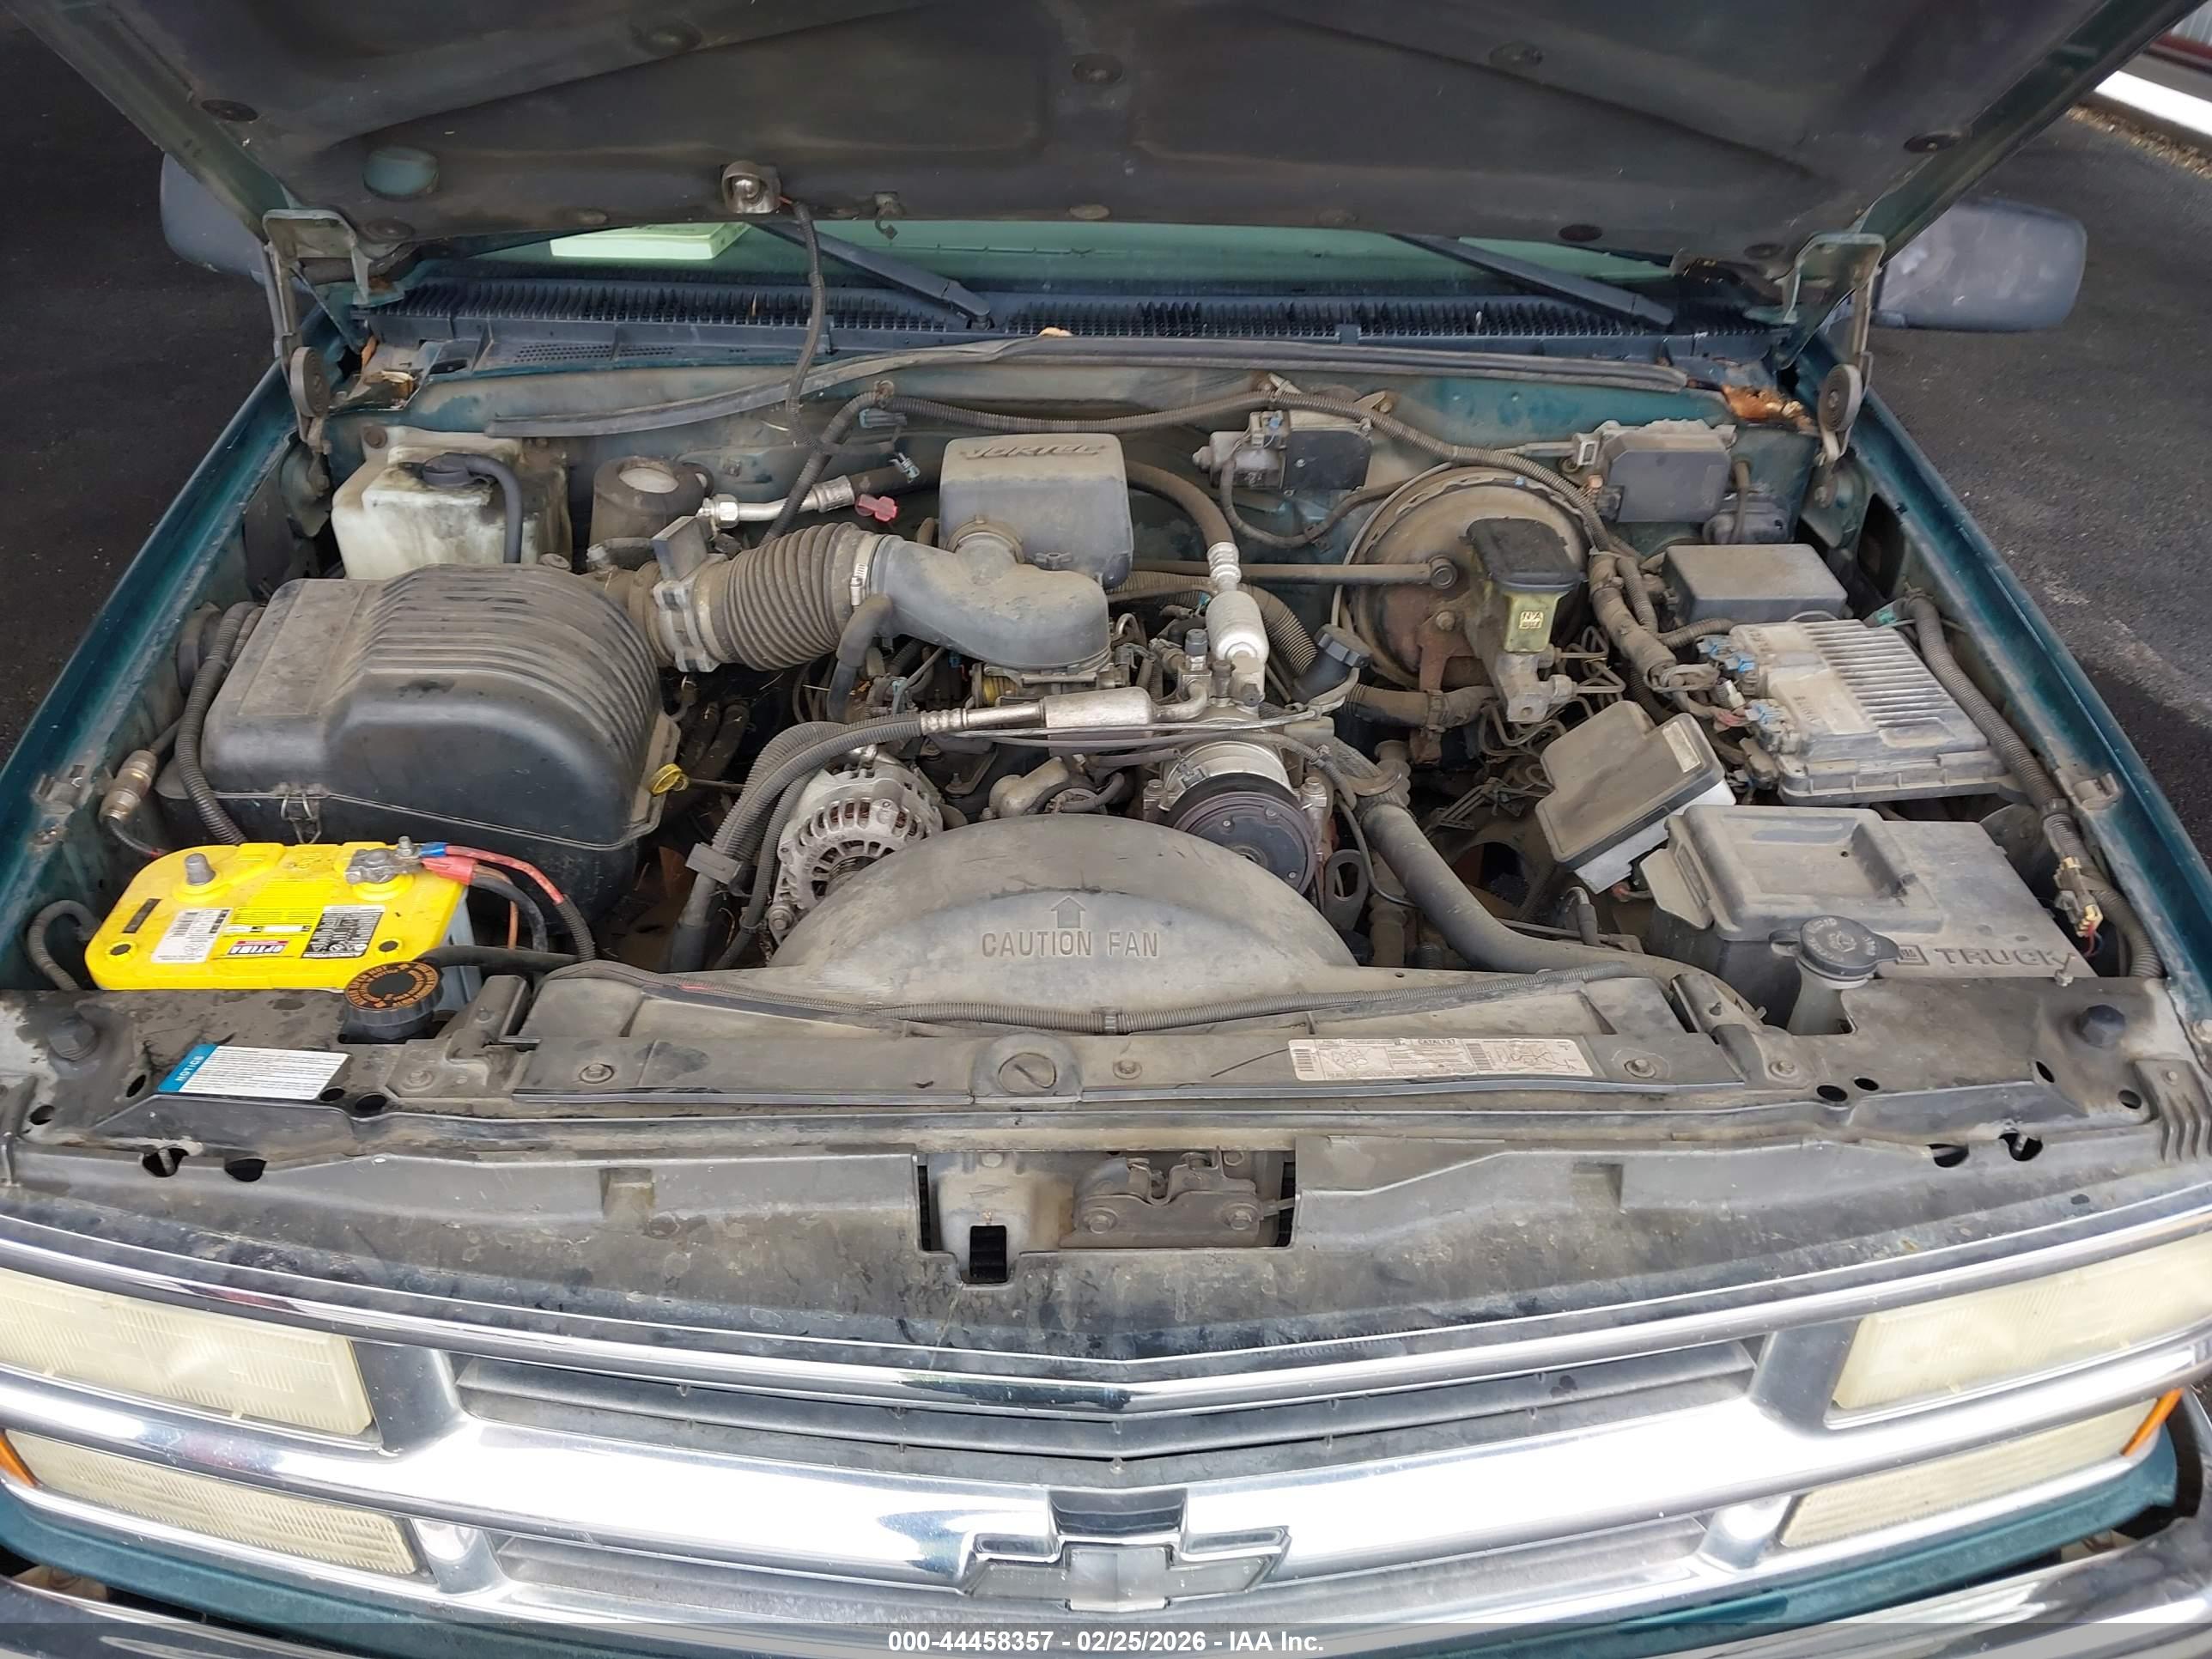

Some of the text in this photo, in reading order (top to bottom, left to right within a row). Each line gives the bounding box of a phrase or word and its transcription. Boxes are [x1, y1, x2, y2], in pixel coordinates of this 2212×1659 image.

[228, 945, 285, 955] OPTIMA
[981, 930, 1158, 957] CAUTION FAN
[1934, 947, 2069, 966] TRUCK
[174, 1054, 205, 1082] NOTICE
